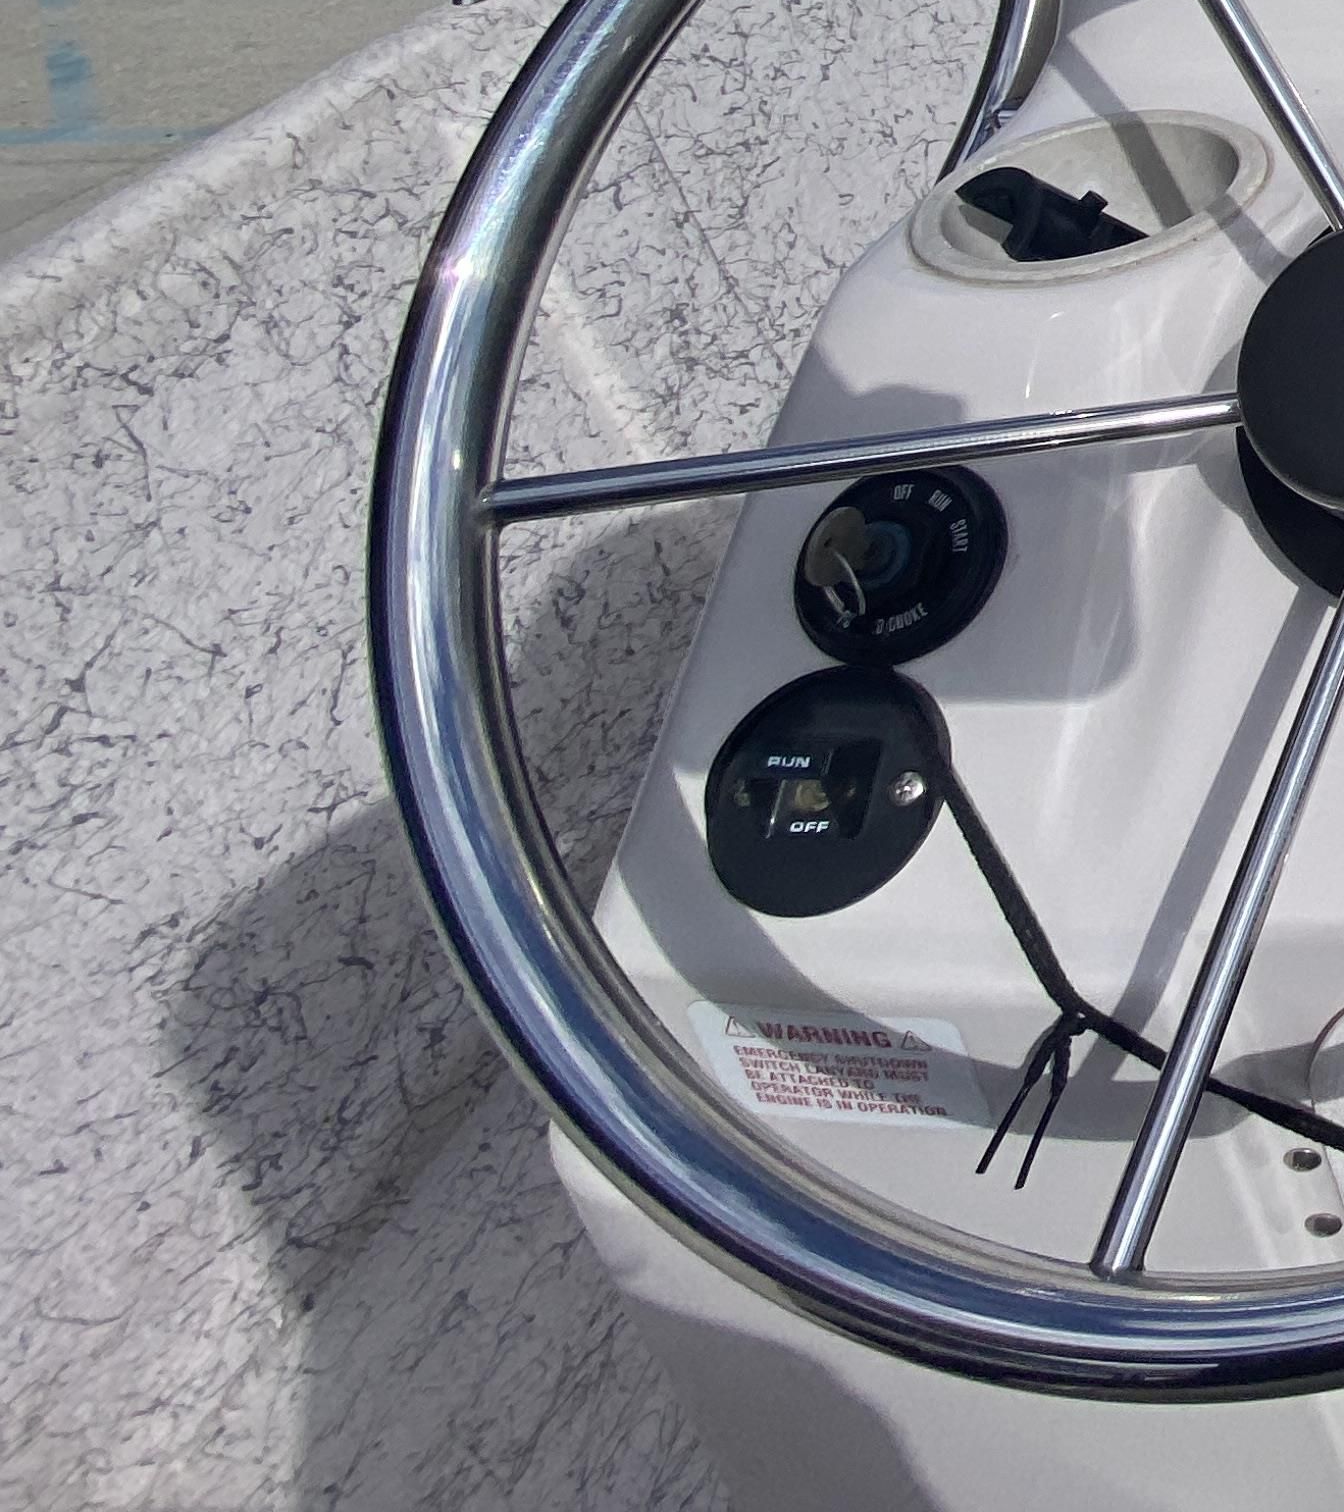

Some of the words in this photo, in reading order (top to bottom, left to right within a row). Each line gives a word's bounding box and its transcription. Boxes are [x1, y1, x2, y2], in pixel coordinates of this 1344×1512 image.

[893, 483, 916, 501] OFF
[928, 489, 953, 513] RUN
[950, 518, 969, 552] START
[889, 601, 929, 633] CHOKE
[767, 754, 811, 769] RUN
[789, 820, 830, 834] OFF
[757, 1022, 892, 1048] WARNING
[733, 1044, 831, 1065] EMERGENCY
[833, 1052, 929, 1070] SHUTDOWN
[739, 1056, 801, 1074] SWITCH
[804, 1061, 880, 1080] LANYARD
[883, 1067, 929, 1081] MUST
[746, 1068, 766, 1081] BE
[769, 1070, 850, 1090] ATTACHED
[854, 1078, 875, 1090] TO
[751, 1080, 835, 1100] OPERATOR
[838, 1088, 889, 1103] WHILE
[755, 1091, 811, 1109] ENGINE
[816, 1098, 833, 1110] IS
[836, 1099, 854, 1112] IN
[856, 1101, 948, 1118] OPERATION
